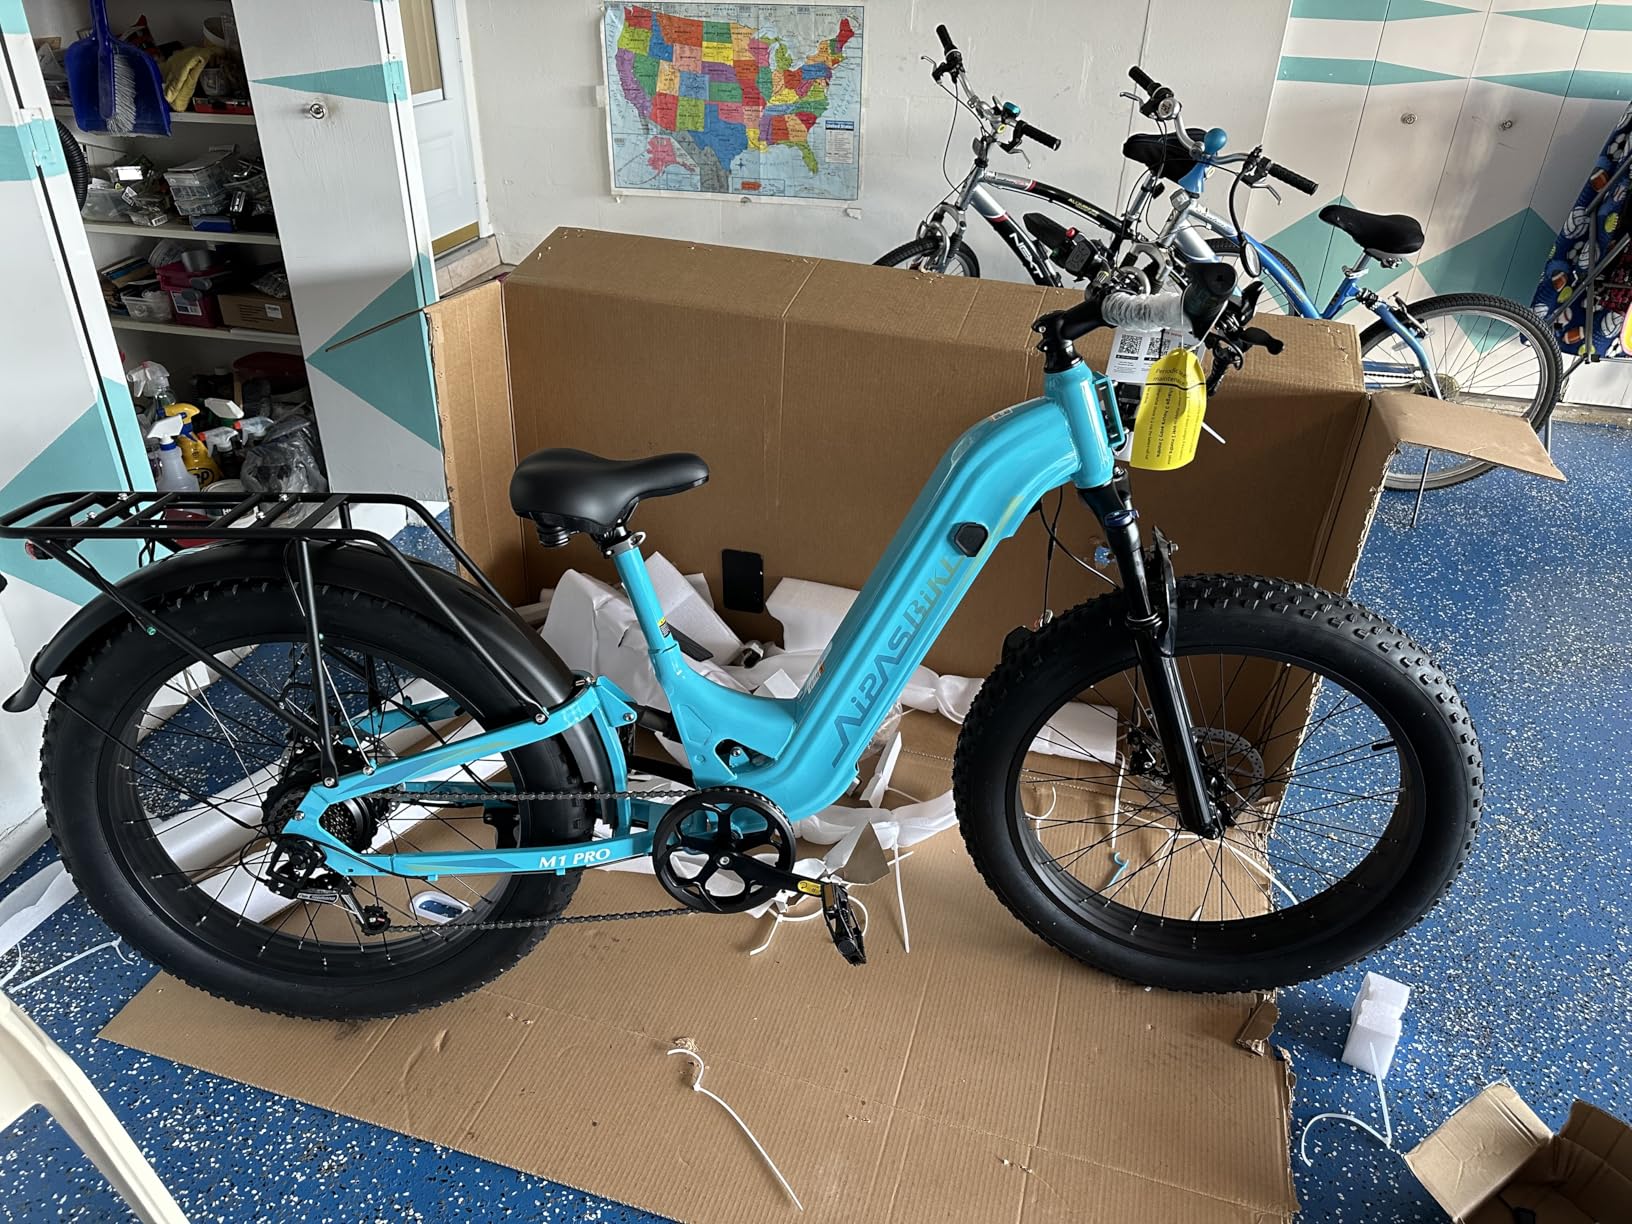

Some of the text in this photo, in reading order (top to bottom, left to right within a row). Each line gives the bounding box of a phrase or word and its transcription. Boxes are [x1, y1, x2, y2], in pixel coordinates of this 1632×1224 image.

[1009, 233, 1044, 278] NEXT
[538, 848, 611, 868] M1 PRO
